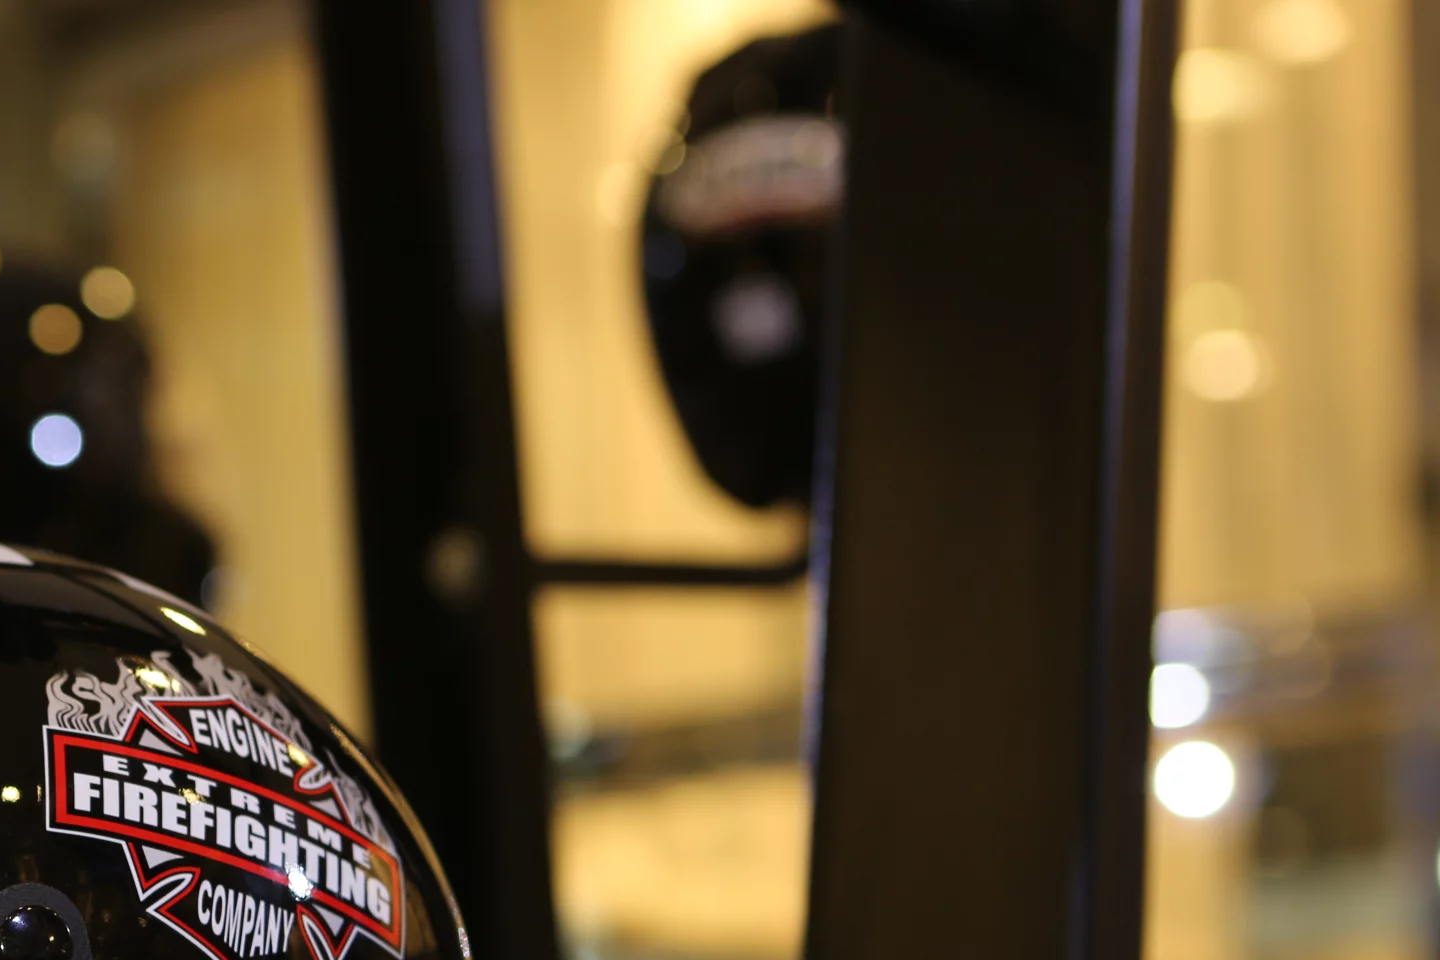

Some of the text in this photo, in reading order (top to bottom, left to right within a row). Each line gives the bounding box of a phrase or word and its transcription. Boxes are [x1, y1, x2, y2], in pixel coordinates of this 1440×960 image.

[189, 708, 293, 778] ENGINE
[73, 772, 392, 925] FIREFIGHTING
[103, 754, 371, 869] EXTREME
[197, 879, 295, 959] COMPANY
